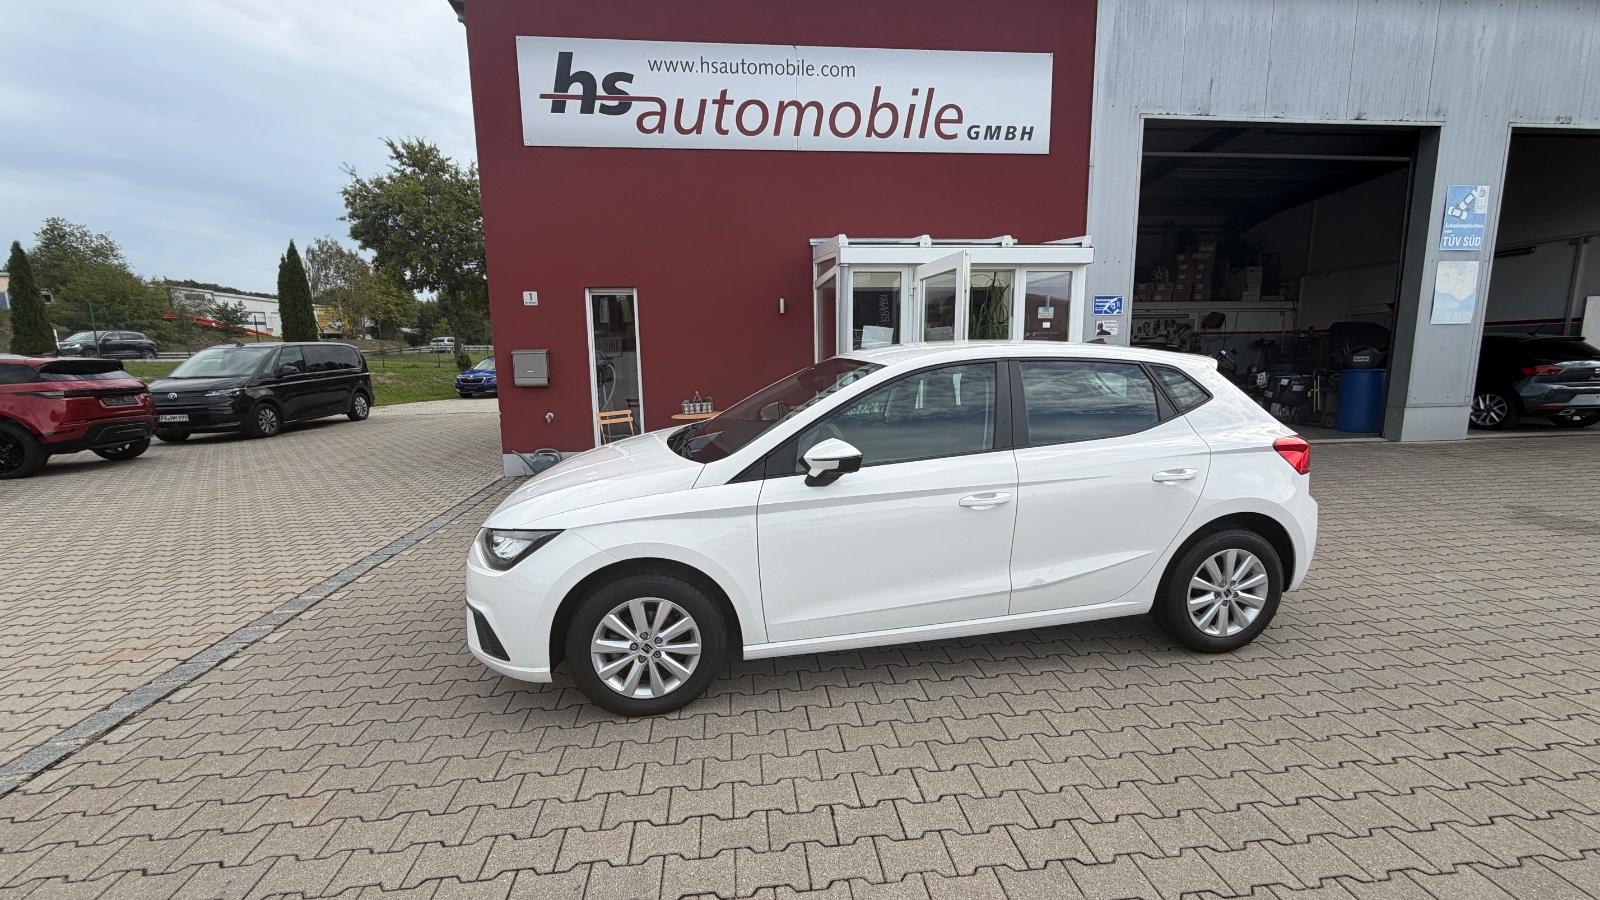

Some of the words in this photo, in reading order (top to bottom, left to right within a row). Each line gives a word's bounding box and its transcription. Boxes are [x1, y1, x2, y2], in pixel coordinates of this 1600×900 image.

[648, 56, 856, 78] www.hsautomobile.com
[552, 51, 634, 115] hs
[635, 86, 964, 140] automobile
[966, 124, 1036, 142] GMBH
[1442, 234, 1461, 247] TÜV
[1463, 235, 1481, 247] SÜD
[528, 292, 533, 301] 1
